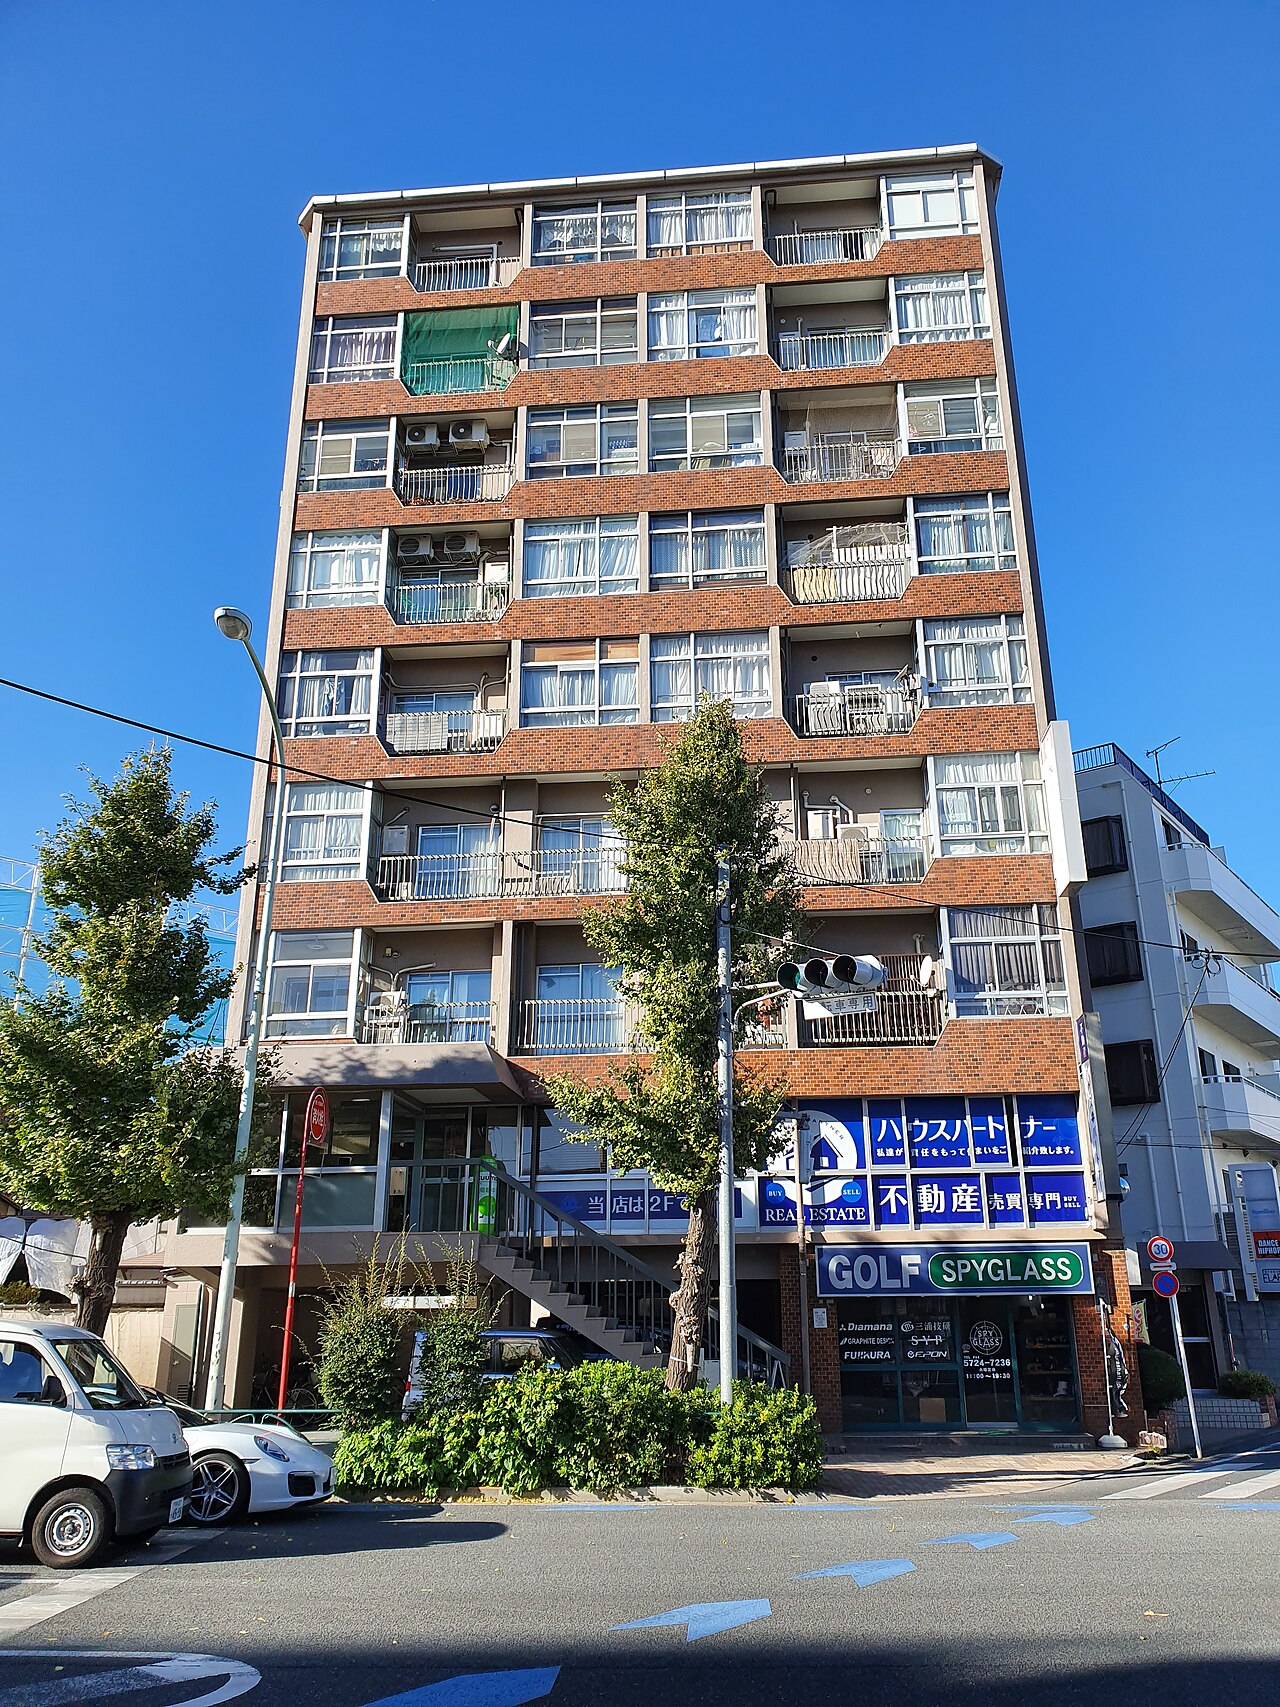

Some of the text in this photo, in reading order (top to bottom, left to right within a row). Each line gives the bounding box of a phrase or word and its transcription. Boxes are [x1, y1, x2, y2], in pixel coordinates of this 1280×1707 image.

[878, 1183, 1061, 1214] 不動産 売買専門
[809, 1207, 866, 1221] ESTATE
[1258, 1239, 1280, 1247] DANCE
[1153, 1243, 1168, 1255] 30
[828, 1254, 1073, 1289] GOLF SPYGLASS
[847, 1322, 893, 1331] Diamana
[977, 1330, 993, 1338] SPY
[847, 1337, 876, 1345] GRAPHITE
[972, 1338, 1000, 1348] GLASS
[844, 1351, 891, 1360] FUJIKURA
[914, 1350, 948, 1358] EPON
[963, 1358, 1011, 1367] 5724-7236
